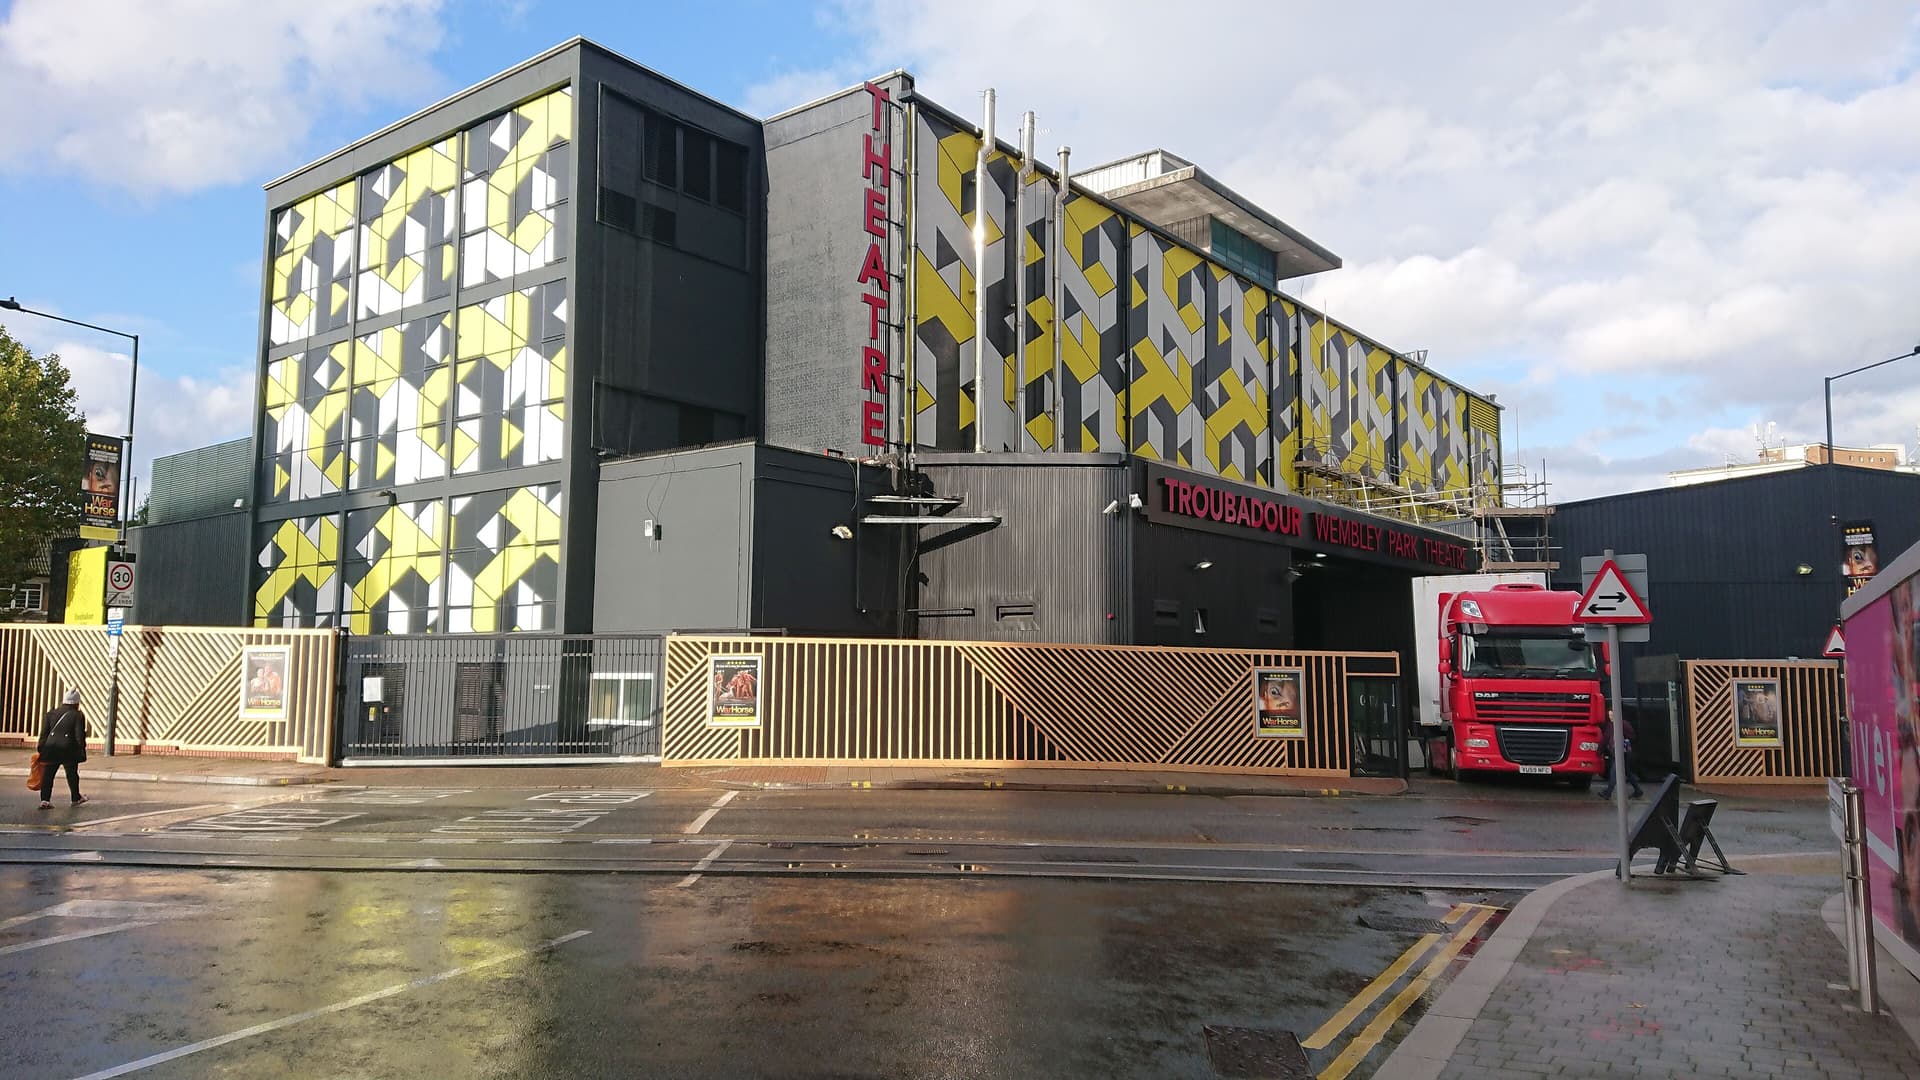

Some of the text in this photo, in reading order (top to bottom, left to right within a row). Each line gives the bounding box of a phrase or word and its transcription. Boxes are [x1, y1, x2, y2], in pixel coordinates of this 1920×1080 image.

[857, 81, 890, 446] THEATRE
[91, 496, 113, 507] War
[84, 503, 115, 516] Horse
[1164, 478, 1469, 570] TROUBADOUR WEMBLEY PARK THEATRE
[113, 571, 130, 583] 30
[716, 706, 754, 714] War Horse
[1262, 717, 1298, 726] War Horse
[1741, 727, 1776, 737] War Horse
